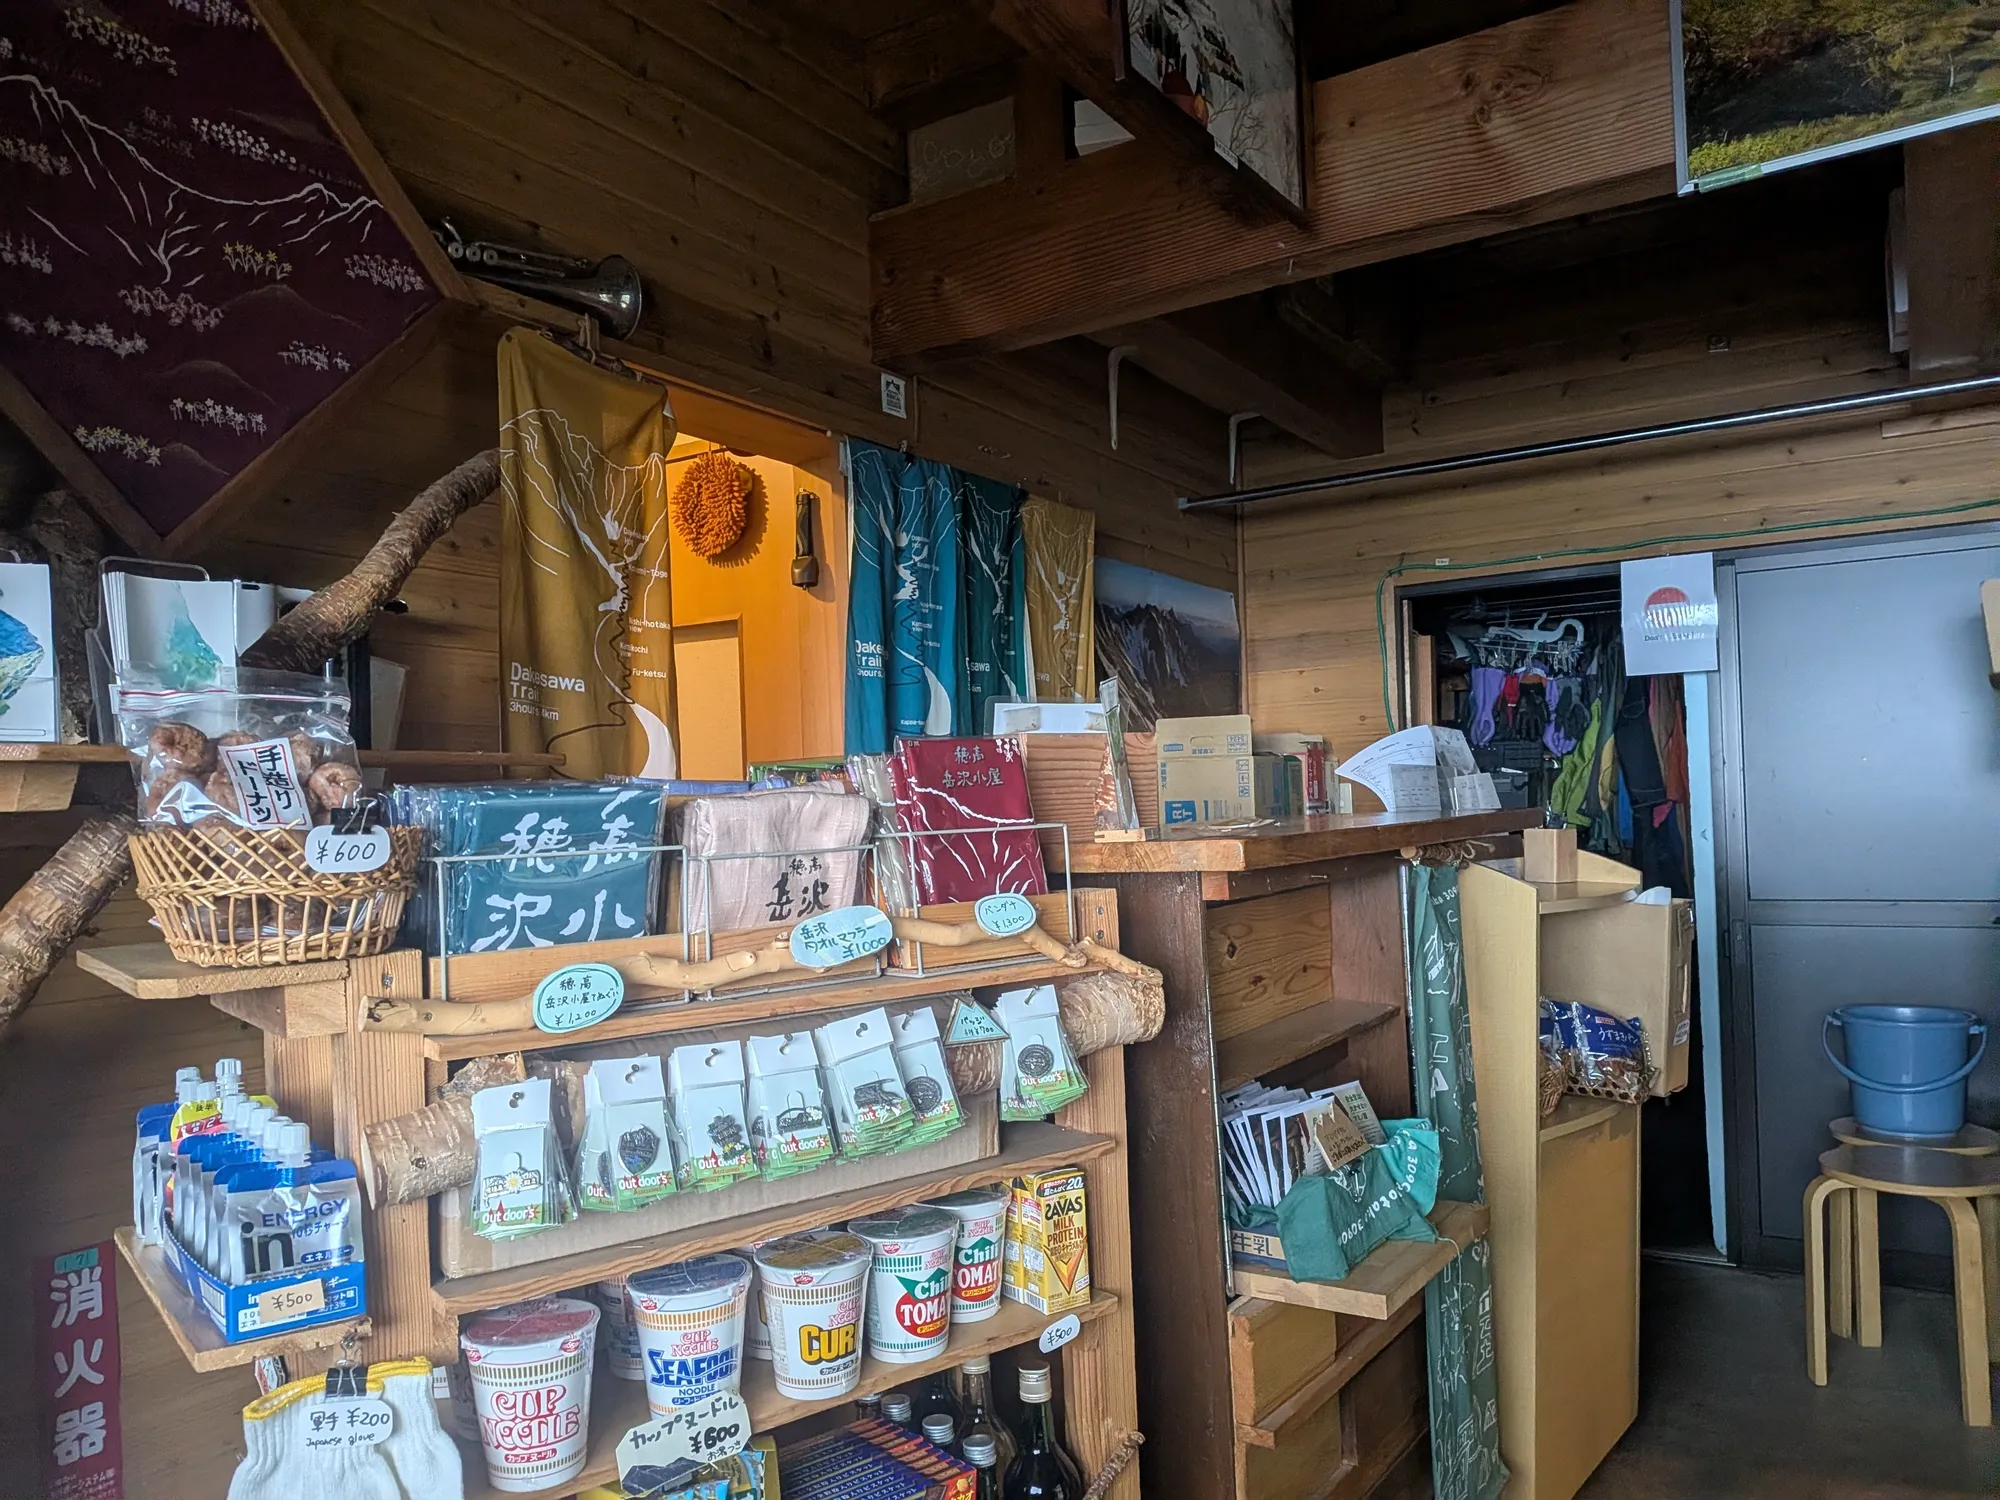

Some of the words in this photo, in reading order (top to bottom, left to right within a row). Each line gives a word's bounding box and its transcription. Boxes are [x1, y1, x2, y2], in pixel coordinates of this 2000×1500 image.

[257, 745, 292, 811] 手造り
[237, 758, 272, 824] ドーナツ
[316, 839, 377, 865] ¥600
[984, 900, 1018, 916] バンダナ
[800, 921, 829, 942] 岳沢
[804, 925, 878, 953] タオルマフラー
[842, 936, 888, 960] ¥1000
[262, 1198, 348, 1228] ENERGY
[1044, 1196, 1084, 1221] SAVAS
[1053, 1215, 1076, 1233] MILK
[241, 1221, 295, 1275] in
[1047, 1227, 1084, 1247] PROTEIN
[1232, 1233, 1273, 1257] 牛乳
[914, 1271, 950, 1300] Chil
[271, 1292, 313, 1311] ¥500
[671, 1338, 719, 1357] NOODLE
[680, 1330, 711, 1344] CUP
[50, 1266, 107, 1466] 消火器
[647, 1343, 739, 1388] SEAFOOD
[678, 1383, 715, 1396] NOODLE
[491, 1385, 567, 1420] CUP
[310, 1411, 339, 1432] 軍手
[346, 1407, 391, 1429] ¥200
[479, 1403, 580, 1452] NOODLE
[629, 1397, 739, 1450] カップヌードル
[305, 1436, 343, 1450] Japanese
[348, 1433, 376, 1446] glove
[688, 1423, 740, 1454] ¥600
